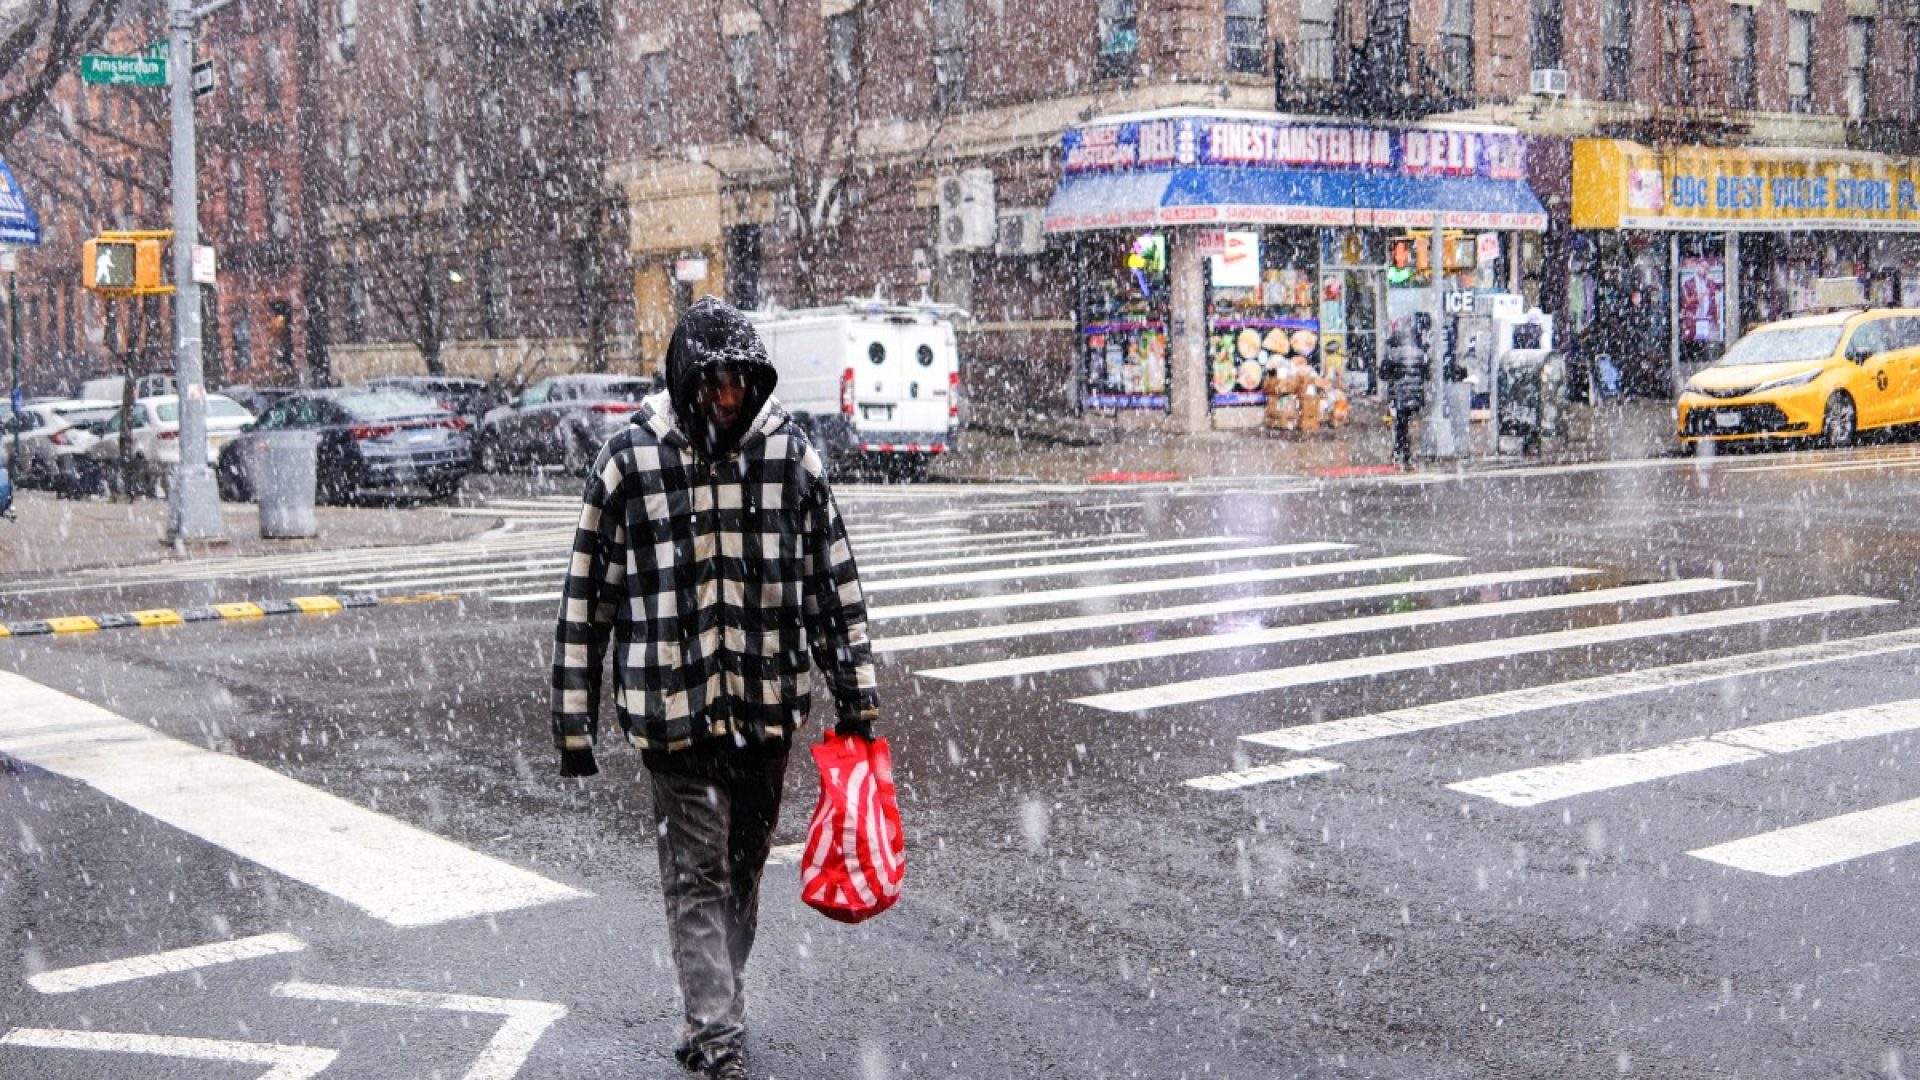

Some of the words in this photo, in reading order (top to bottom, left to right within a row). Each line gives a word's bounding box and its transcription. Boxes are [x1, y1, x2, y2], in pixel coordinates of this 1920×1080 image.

[92, 58, 159, 73] Amsterdam
[1212, 124, 1272, 159] FINEST
[1278, 127, 1390, 163] AMSTERDAM
[1407, 132, 1475, 168] DELI
[1716, 175, 1764, 208] BEST
[1772, 175, 1829, 208] VALUE
[1836, 178, 1891, 209] STORE
[1446, 290, 1473, 312] ICE
